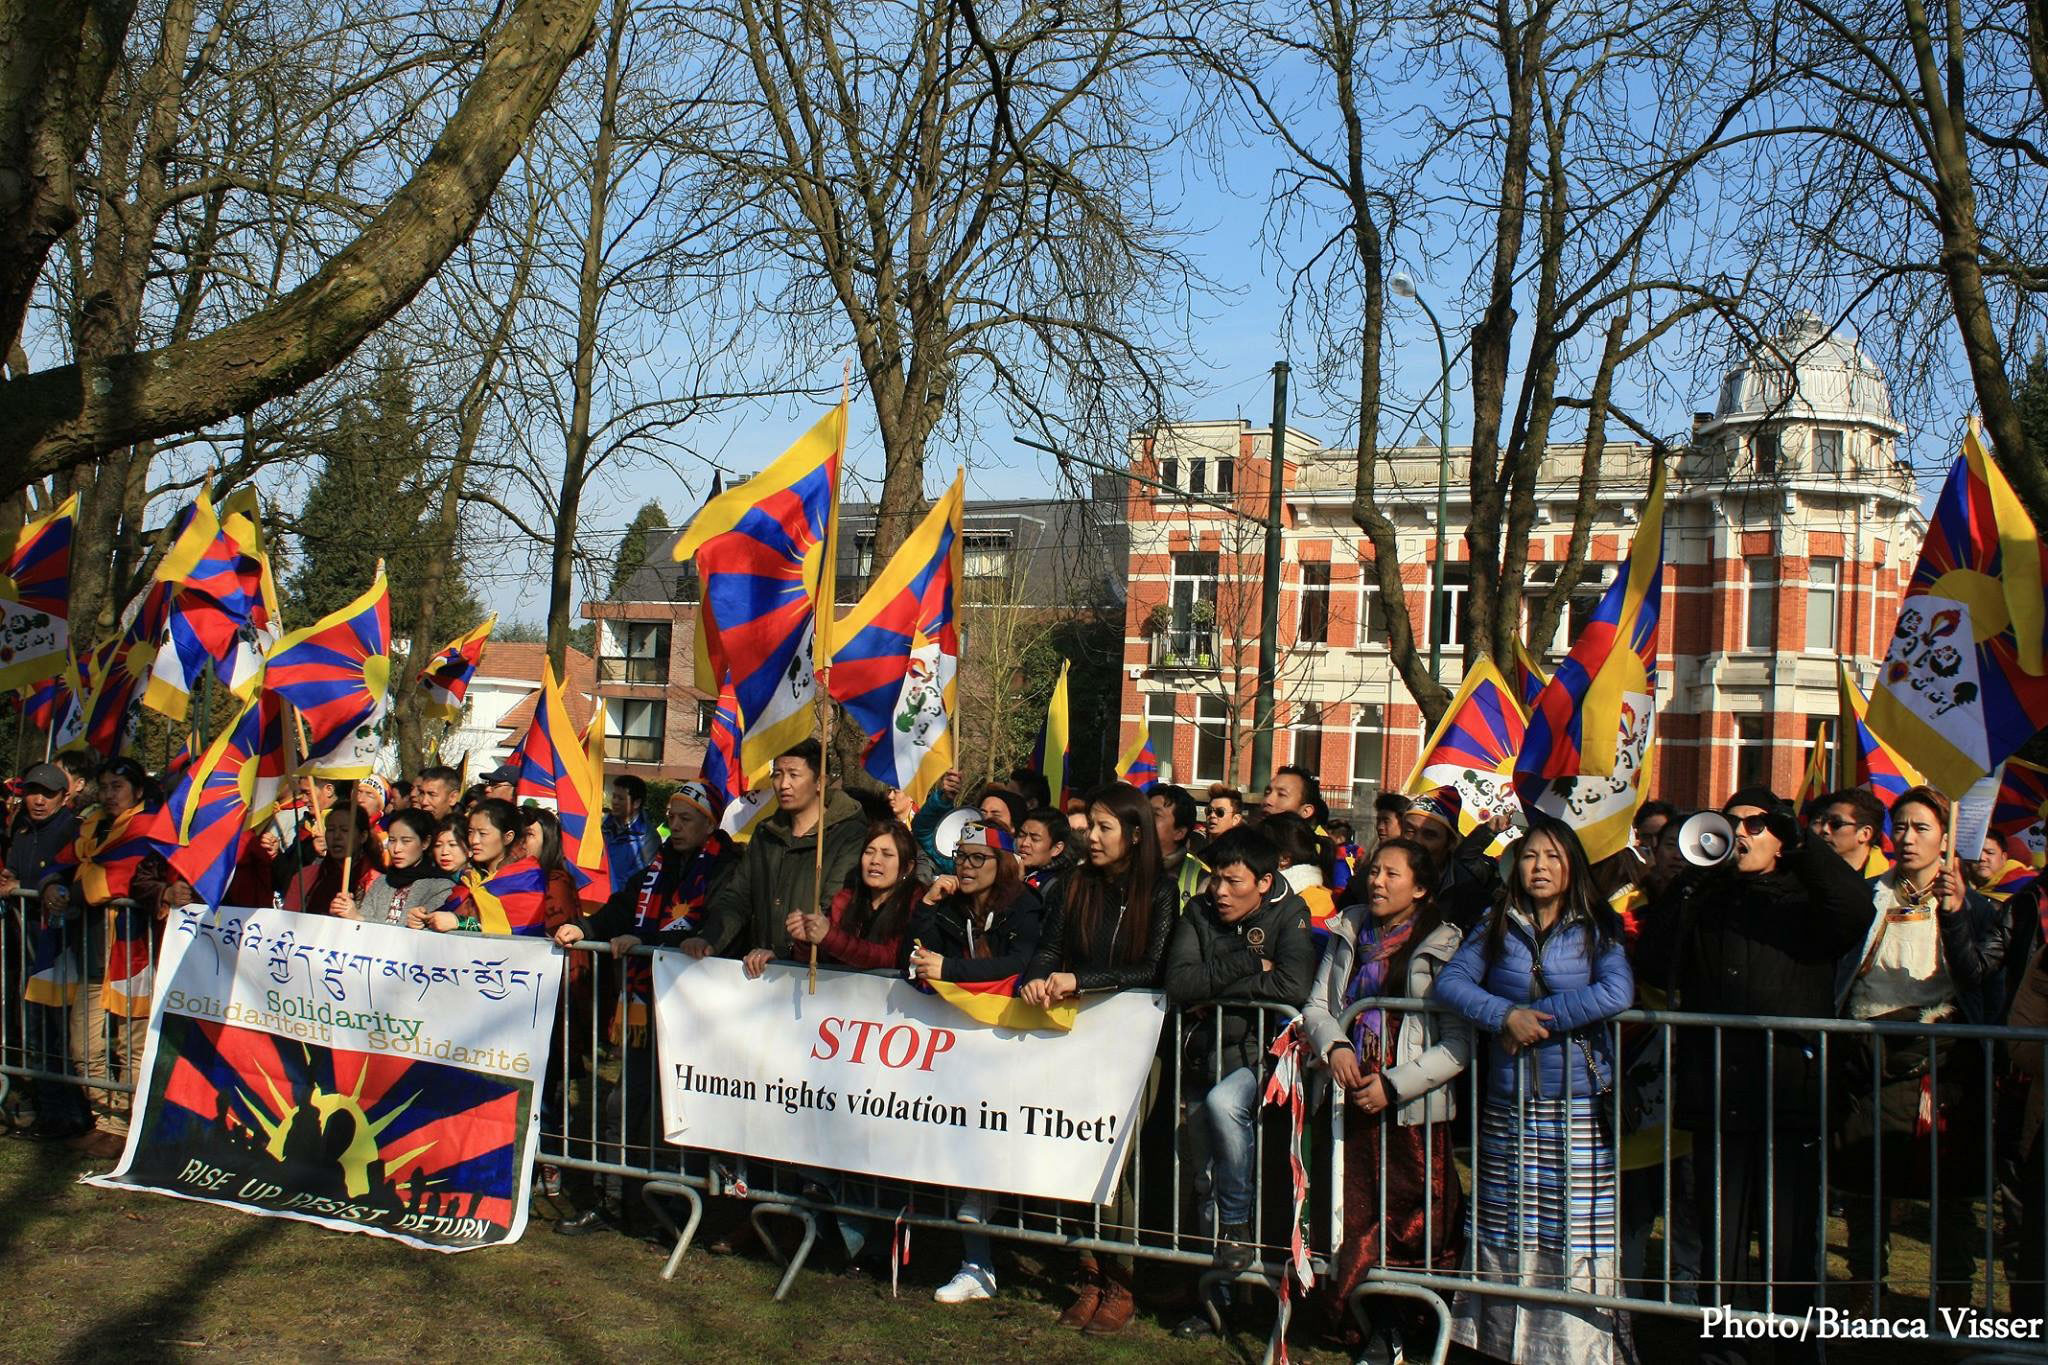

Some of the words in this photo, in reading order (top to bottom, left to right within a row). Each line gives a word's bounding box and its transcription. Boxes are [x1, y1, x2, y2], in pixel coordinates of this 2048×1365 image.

[166, 990, 331, 1042] Solidariteit
[266, 989, 424, 1041] Solidarity
[368, 1031, 530, 1073] Solidarité
[811, 1016, 956, 1072] STOP
[675, 1063, 757, 1101] Human
[765, 1077, 837, 1114] rights
[847, 1088, 967, 1127] violation
[978, 1101, 1008, 1132] in
[1020, 1105, 1117, 1145] Tibet!
[177, 1158, 236, 1191] RISE
[281, 1192, 390, 1221] RESIST
[392, 1213, 491, 1239] RETURN
